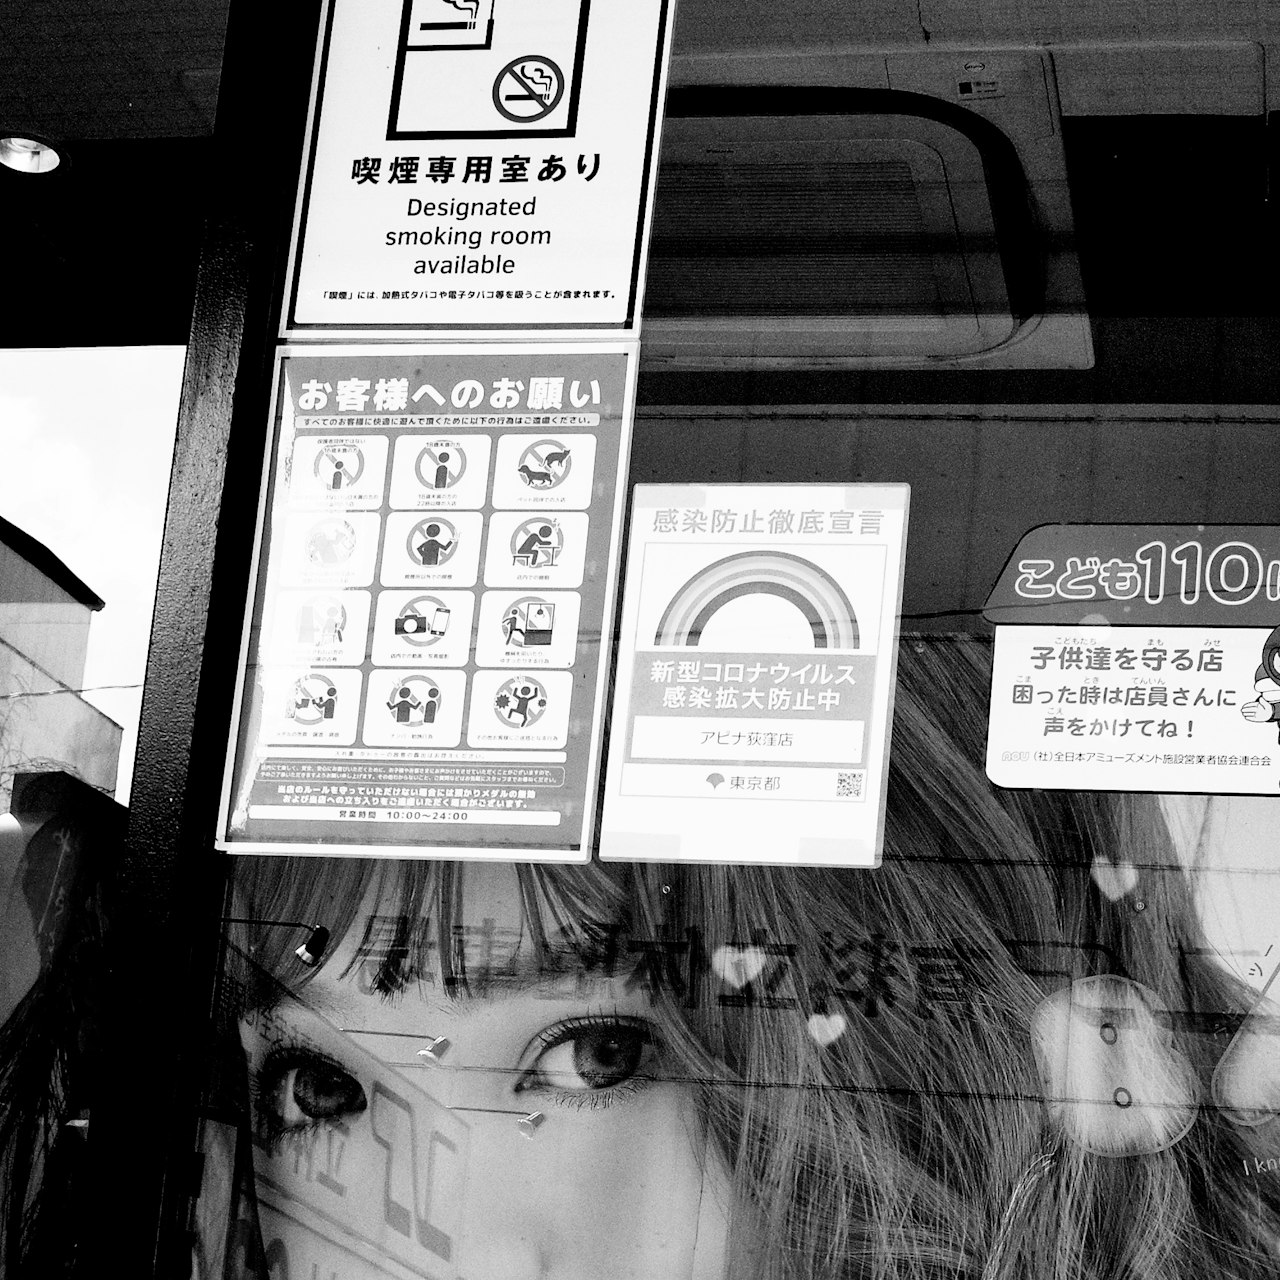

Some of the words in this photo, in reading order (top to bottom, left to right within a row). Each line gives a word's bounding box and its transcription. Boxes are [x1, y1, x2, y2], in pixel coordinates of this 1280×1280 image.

[351, 154, 601, 184] 喫煙専用室あり
[407, 197, 536, 220] Designated
[385, 227, 482, 249] smoking
[490, 229, 551, 245] room
[414, 255, 515, 274] available
[297, 378, 602, 411] お客様へのお願い
[652, 509, 885, 535] 感染防止徹底宣言
[1030, 647, 1223, 673] 子供達を守る店
[651, 660, 856, 685] 新型コロナウイルス
[662, 687, 841, 710] 感染拡大防止中
[1012, 684, 1237, 707] 困った時は店員さんに
[1043, 716, 1194, 738] 声をかけてね！
[730, 775, 781, 791] 東京都
